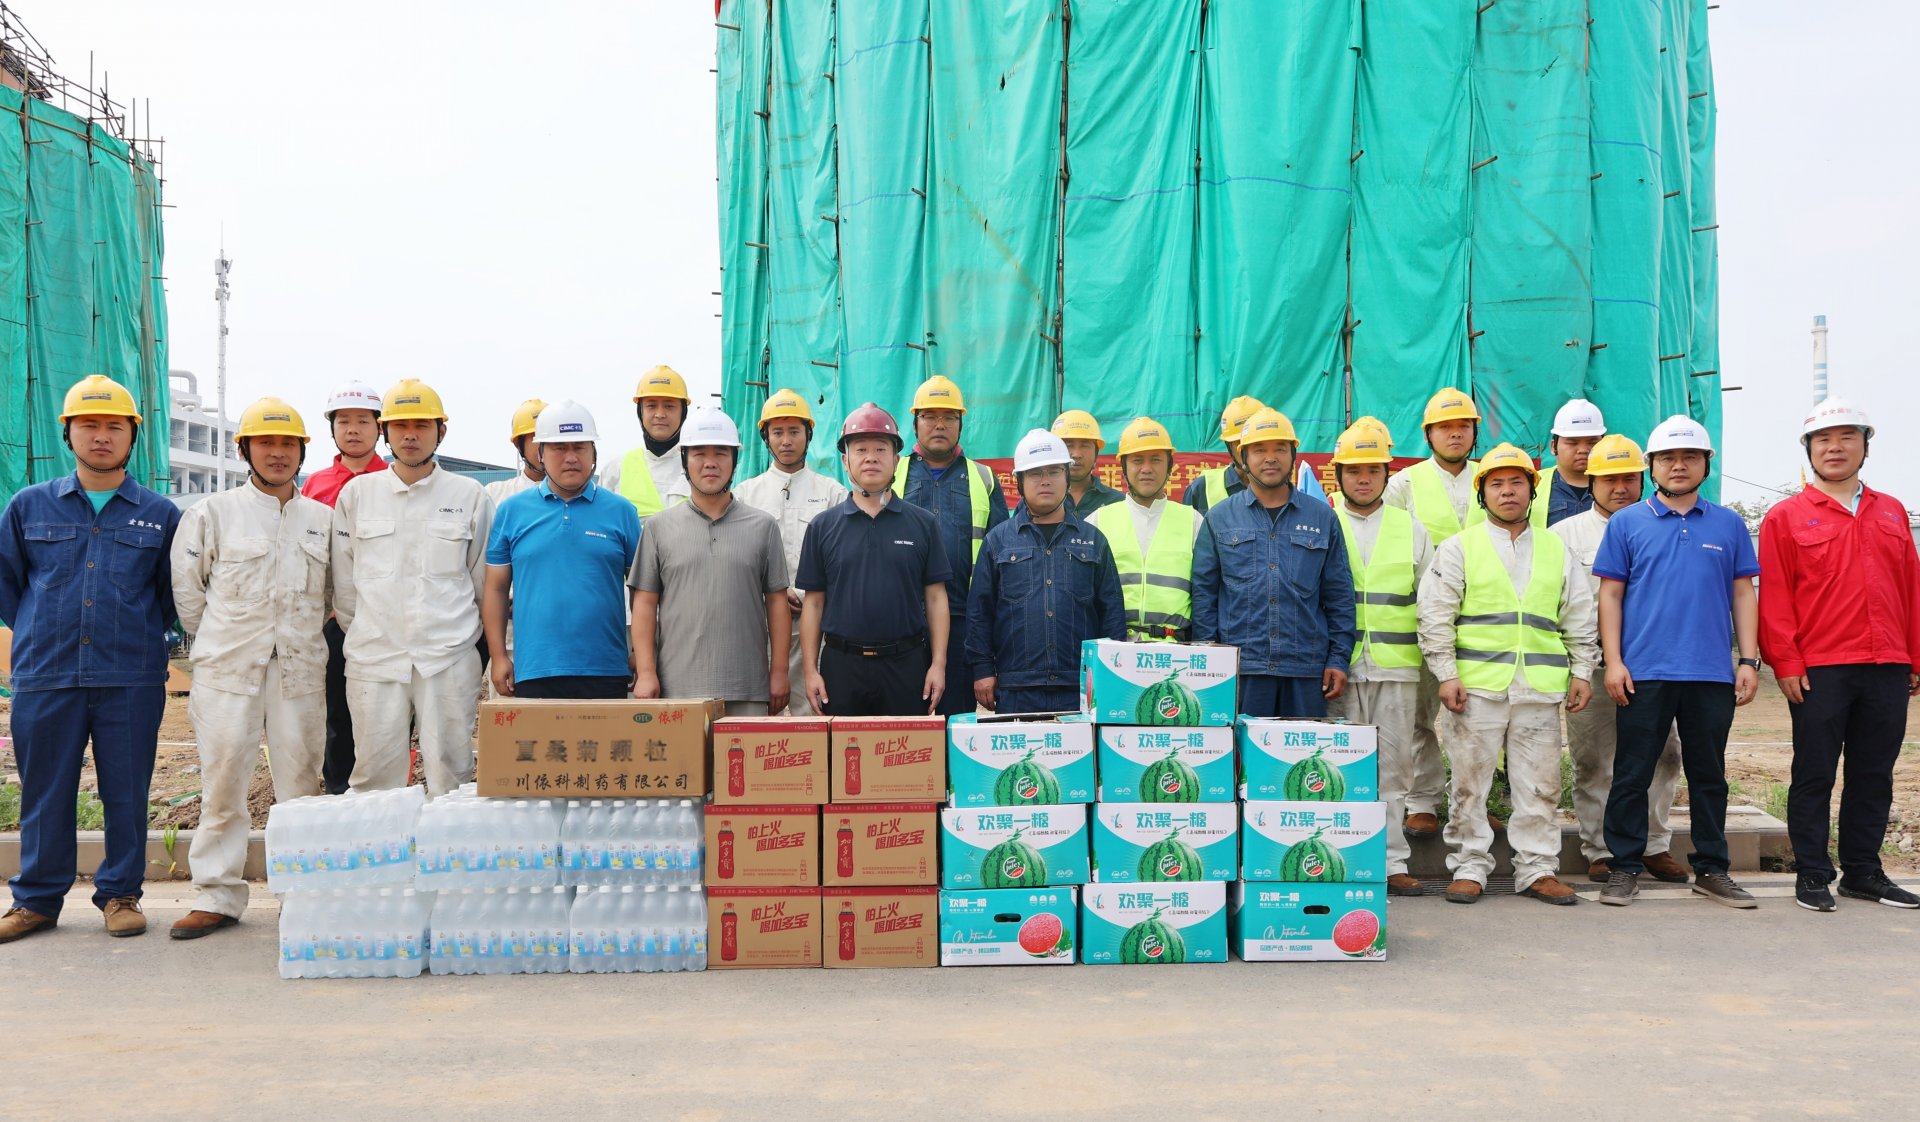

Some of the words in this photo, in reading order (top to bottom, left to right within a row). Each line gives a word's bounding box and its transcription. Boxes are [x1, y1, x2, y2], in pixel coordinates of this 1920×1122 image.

[1136, 652, 1207, 670] 欢聚一糖
[495, 710, 516, 726] 蜀中
[658, 709, 683, 725] 依科
[755, 738, 789, 759] 怕上火
[874, 735, 909, 756] 怕上火
[991, 733, 1062, 751] 欢聚一糖
[1138, 732, 1204, 749] 欢聚一糖
[1284, 731, 1350, 747] 欢聚一糖
[763, 750, 813, 770] 喝加多宝
[883, 746, 932, 767] 喝加多宝
[748, 819, 782, 840] 怕上火
[867, 817, 901, 838] 怕上火
[978, 812, 1049, 831] 欢聚一糖
[1136, 811, 1207, 829] 欢聚一糖
[1280, 811, 1351, 829] 欢聚一糖
[756, 831, 806, 852] 喝加多宝
[875, 829, 925, 850] 喝加多宝
[1119, 892, 1189, 909] 欢聚一糖
[751, 901, 786, 922] 怕上火
[865, 901, 900, 922] 怕上火
[759, 913, 810, 934] 喝加多宝
[873, 913, 923, 934] 喝加多宝
